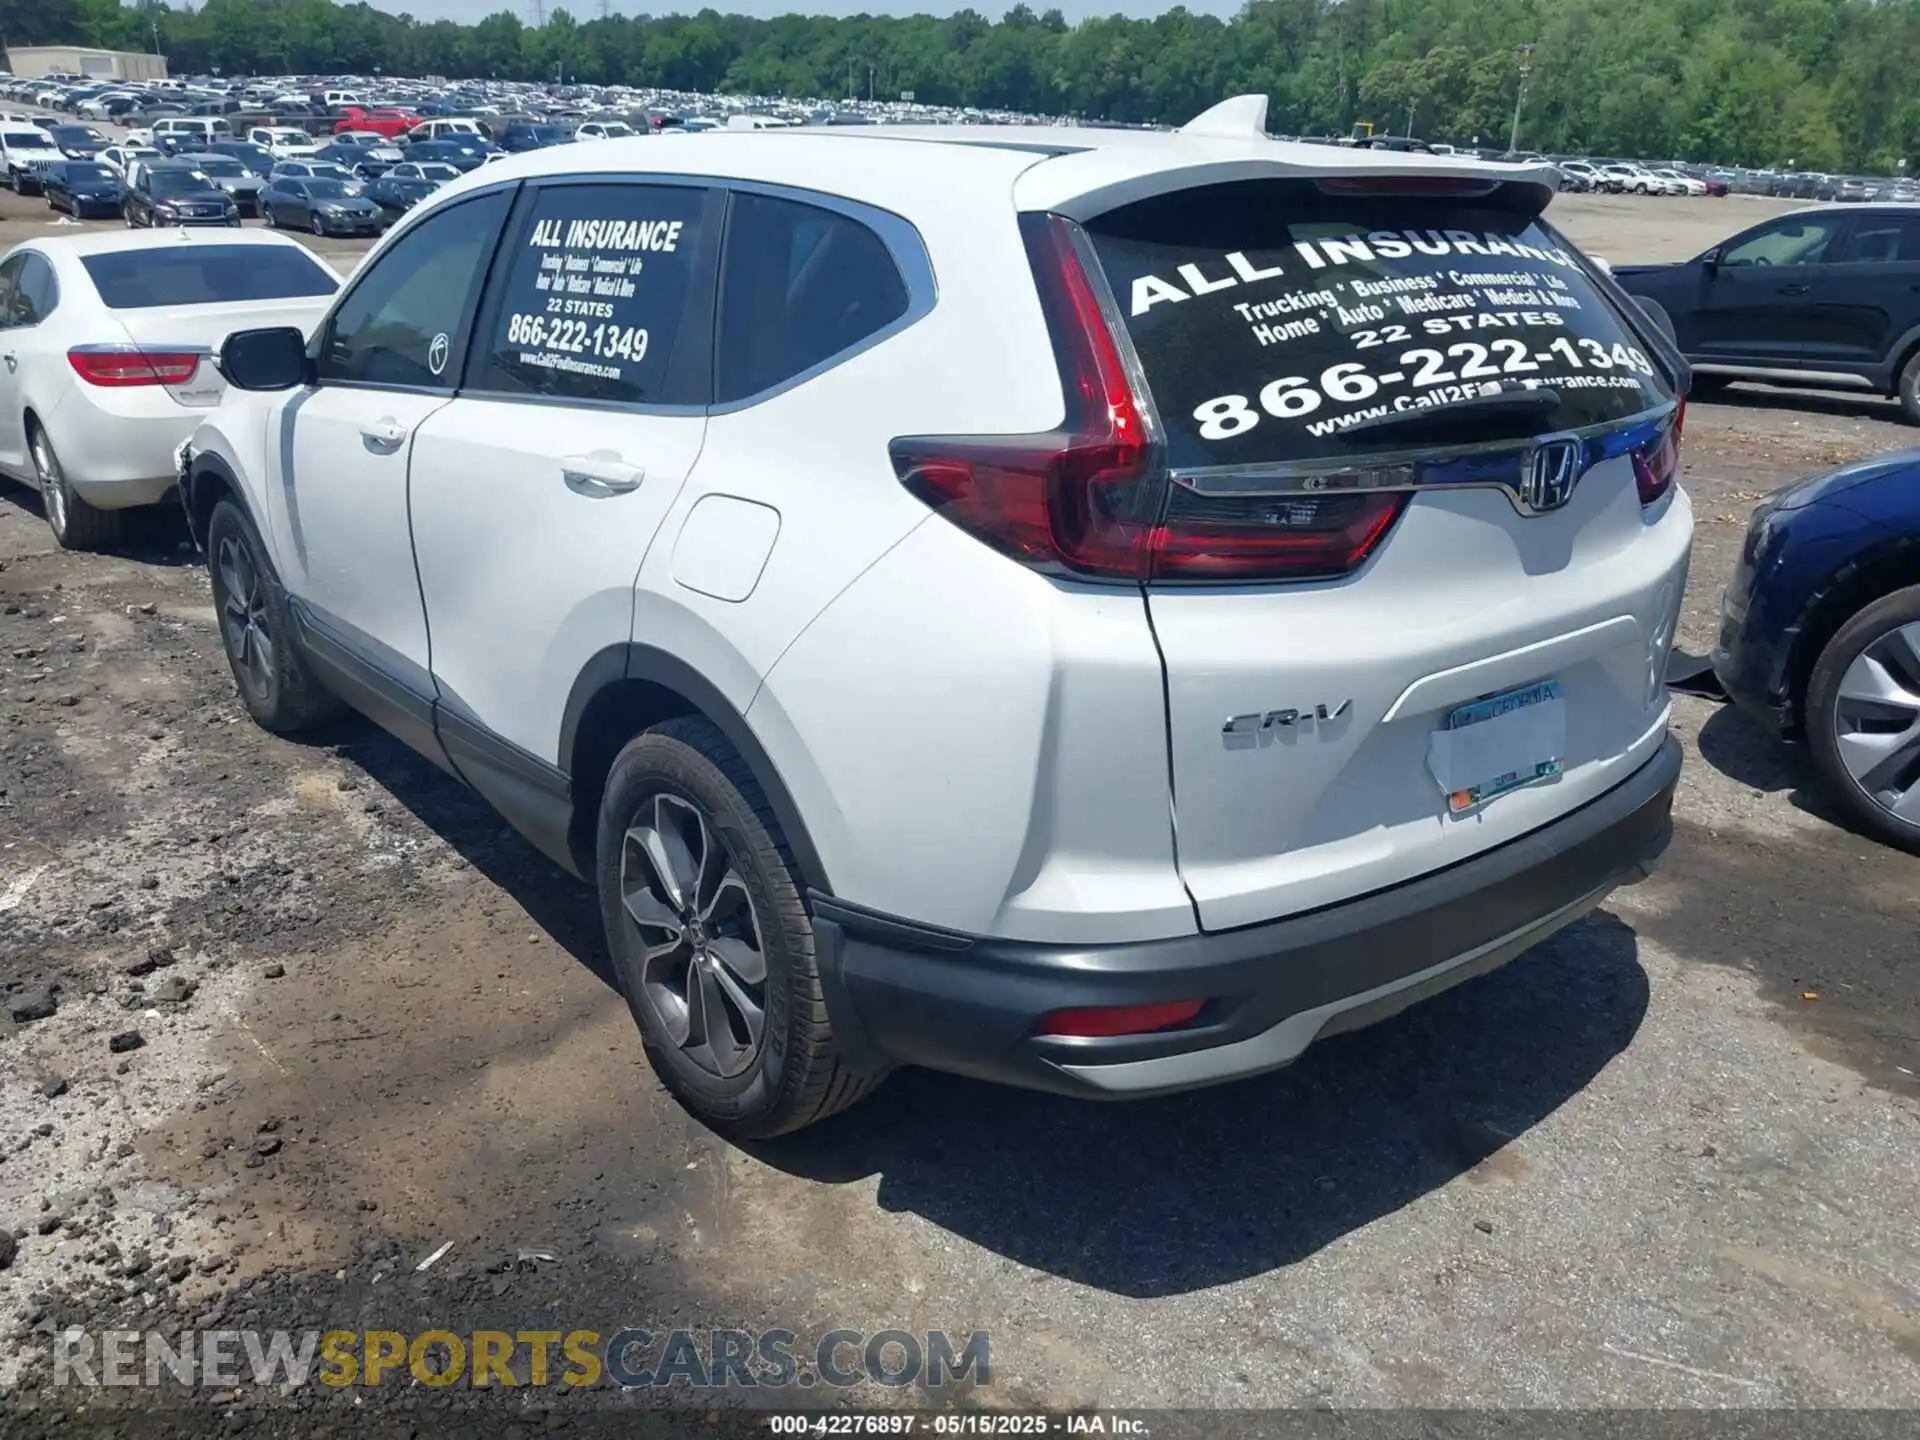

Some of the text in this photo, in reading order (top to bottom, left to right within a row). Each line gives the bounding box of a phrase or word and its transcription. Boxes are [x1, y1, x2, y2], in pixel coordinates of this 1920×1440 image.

[529, 219, 683, 252] ALL INSURANCE
[1131, 229, 1587, 317] ALL INSURANCE
[1233, 290, 1338, 322] Trucking
[1350, 273, 1438, 298] Business
[1449, 271, 1536, 287] Commercial
[547, 297, 614, 318] 22 STATES
[1252, 316, 1321, 346] Home
[1336, 303, 1384, 326] Auto
[1396, 290, 1476, 315] Medicare
[1483, 288, 1540, 308] Medical
[1350, 311, 1564, 349] 22 STATES
[508, 313, 649, 362] 866-222-1349
[1193, 337, 1654, 440] 866-222-1349
